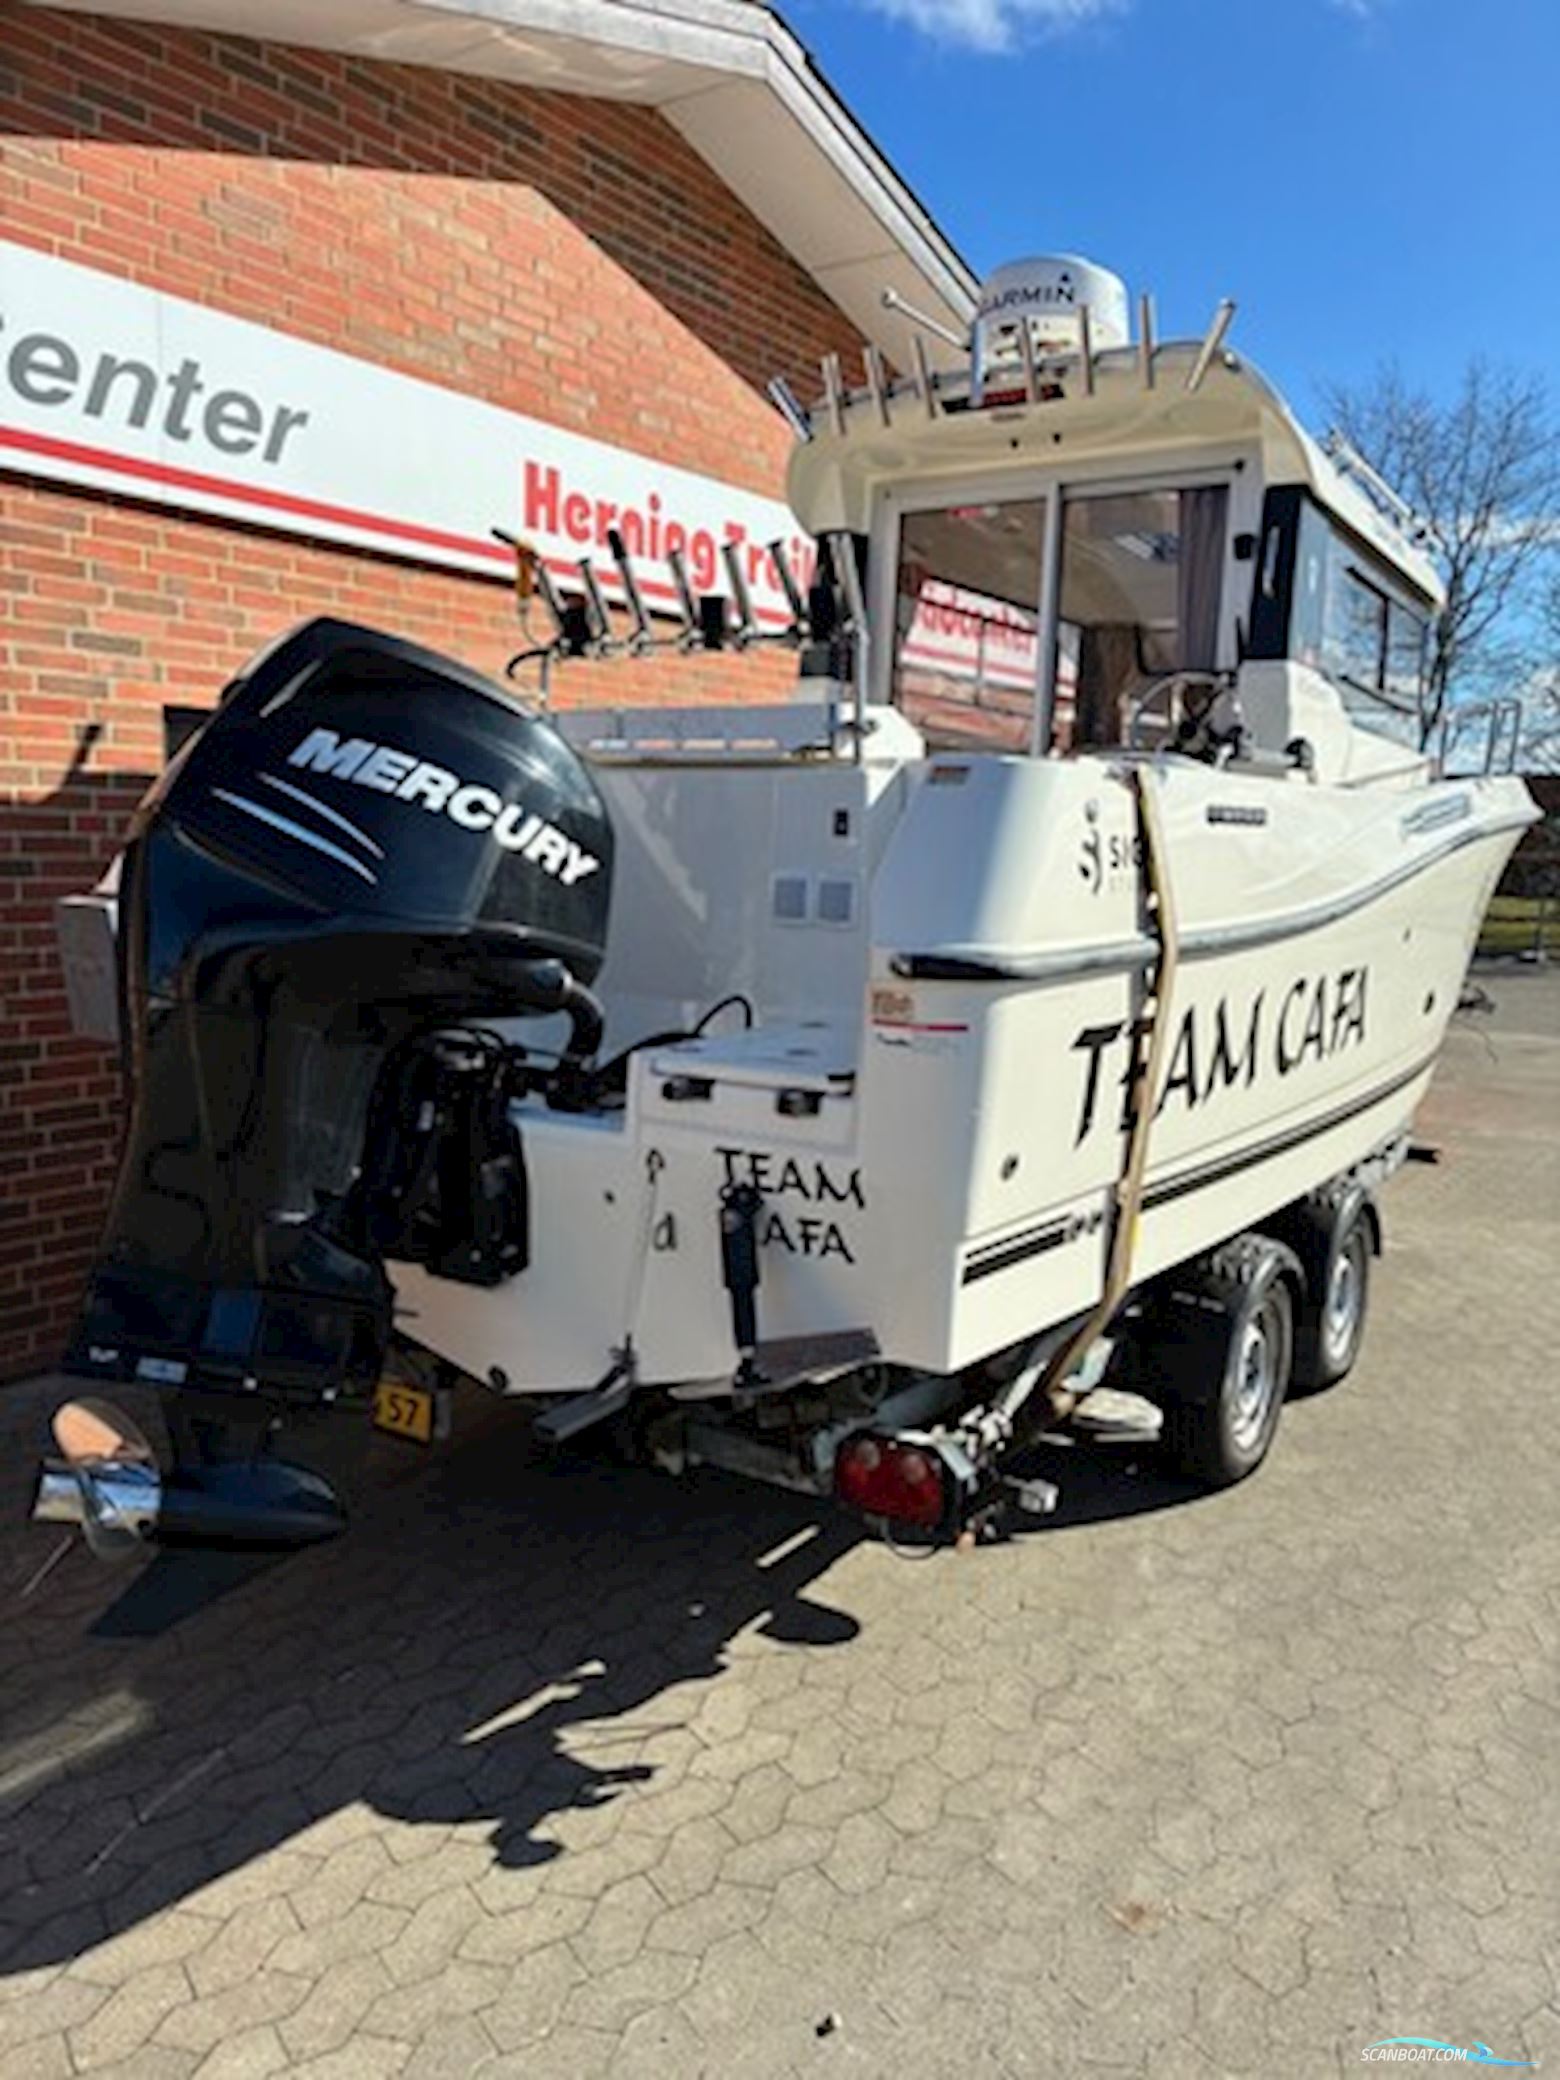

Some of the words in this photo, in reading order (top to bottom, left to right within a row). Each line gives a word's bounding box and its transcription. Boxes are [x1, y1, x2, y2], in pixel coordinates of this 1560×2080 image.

[988, 285, 1075, 310] ARMIN
[0, 333, 310, 463] enter
[288, 727, 600, 887] MERCURY
[1276, 965, 1369, 1076] CAFA
[714, 1146, 866, 1209] TEAM
[760, 1211, 856, 1266] AFA
